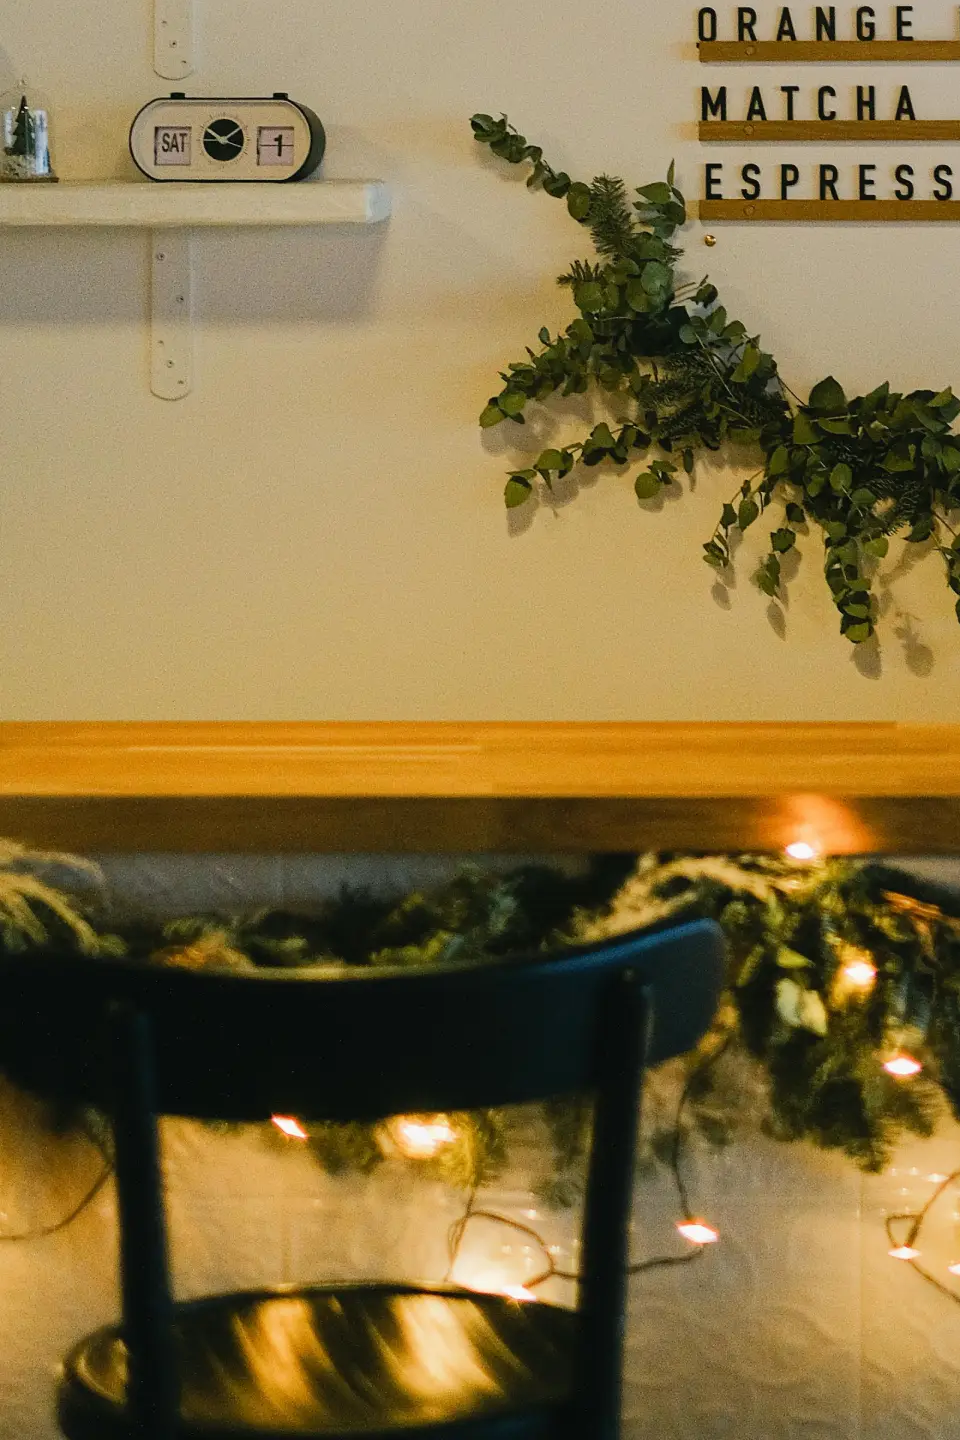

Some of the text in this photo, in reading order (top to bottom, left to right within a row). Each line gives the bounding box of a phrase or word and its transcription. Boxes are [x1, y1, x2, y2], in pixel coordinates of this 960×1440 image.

[698, 5, 914, 41] ORANGE
[701, 85, 916, 121] MATCHA
[161, 131, 188, 153] SAT
[273, 134, 284, 157] 1
